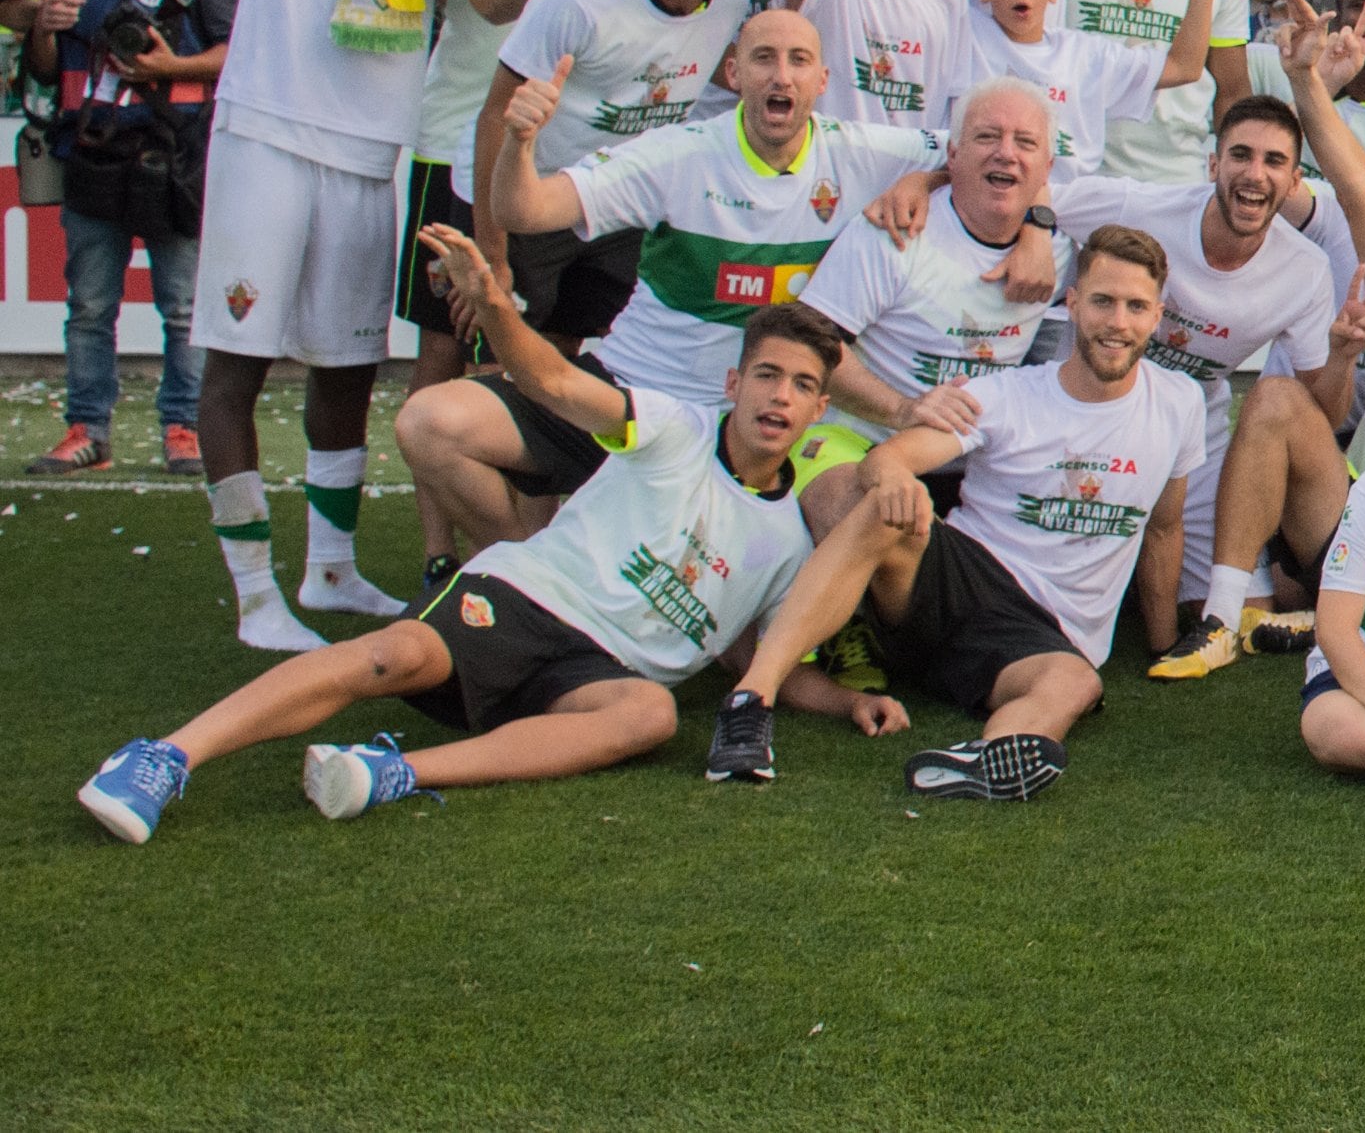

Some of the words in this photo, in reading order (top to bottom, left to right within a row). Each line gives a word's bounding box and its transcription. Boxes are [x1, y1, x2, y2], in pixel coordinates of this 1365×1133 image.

[1100, 5, 1128, 21] UNA
[1131, 9, 1177, 28] FRANJA
[1099, 17, 1174, 40] INVENCIBLE
[900, 41, 922, 56] 2A
[1049, 87, 1067, 103] 2A
[704, 190, 756, 211] KELME
[725, 273, 765, 297] TM
[998, 324, 1021, 338] 2A
[1202, 322, 1230, 339] 2A
[1109, 458, 1138, 475] 2A
[1041, 499, 1071, 516] UNA
[1073, 502, 1127, 520] FRANJA
[1039, 513, 1124, 536] INVENCIBLE
